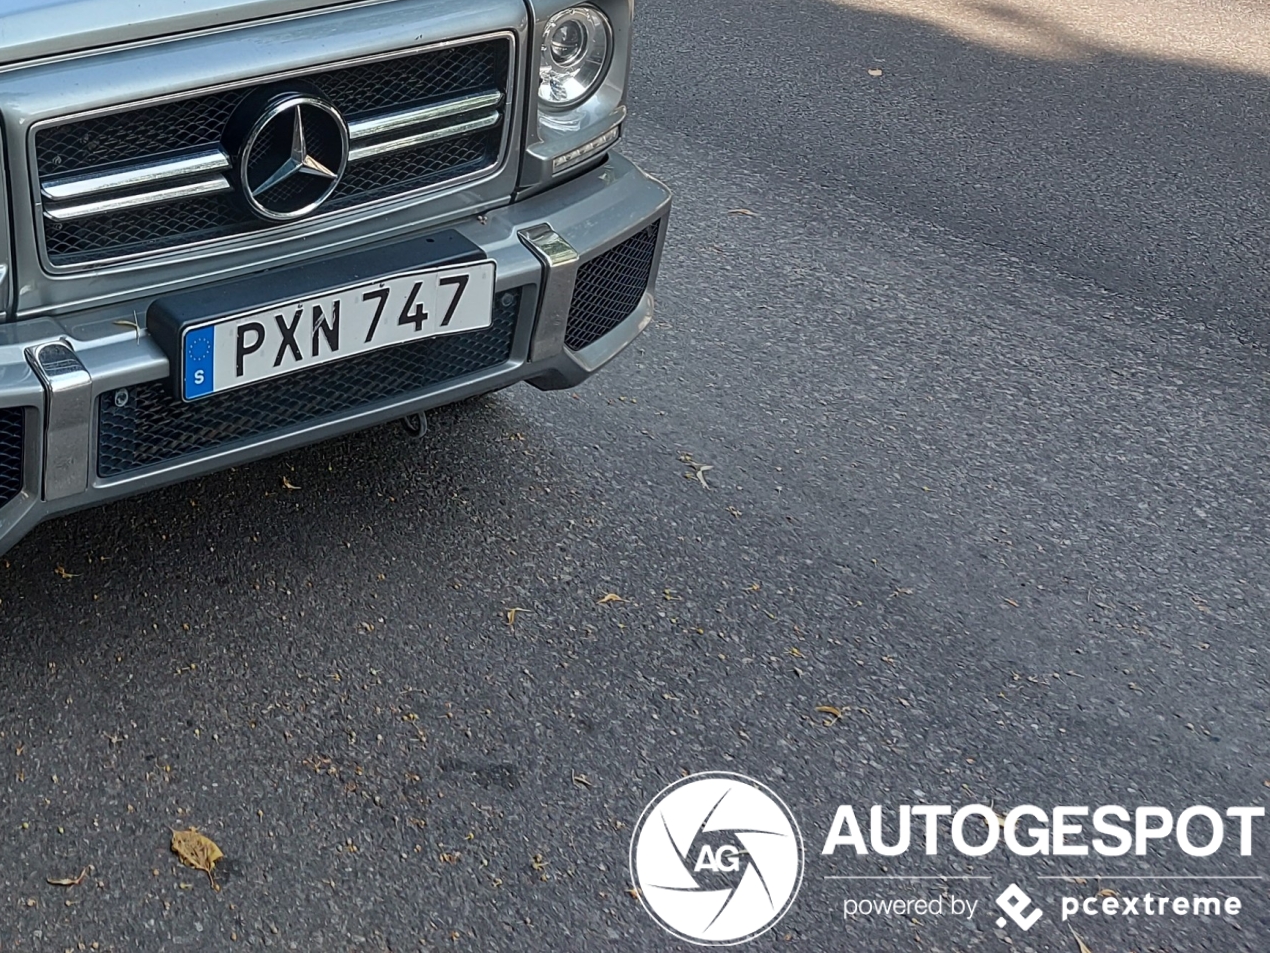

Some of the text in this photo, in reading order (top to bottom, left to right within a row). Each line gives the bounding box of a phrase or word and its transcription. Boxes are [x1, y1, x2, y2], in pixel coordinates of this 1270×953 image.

[235, 274, 470, 377] PXN 747
[194, 369, 205, 385] S
